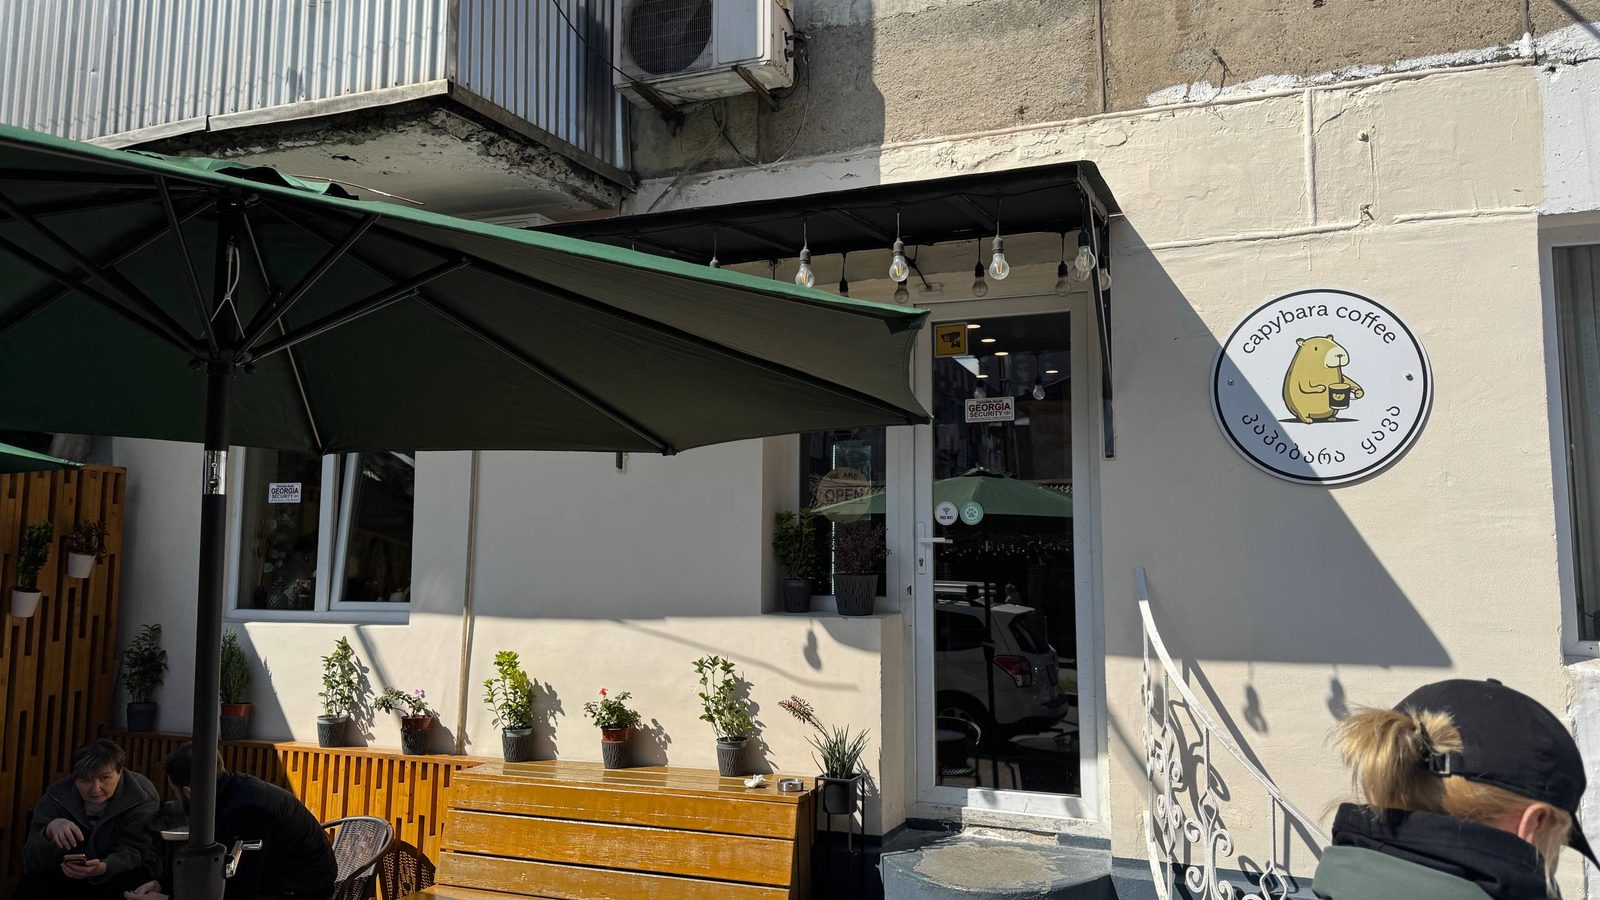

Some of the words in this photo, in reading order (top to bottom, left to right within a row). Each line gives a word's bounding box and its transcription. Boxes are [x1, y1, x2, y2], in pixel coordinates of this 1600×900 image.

[1242, 304, 1329, 354] capybara
[1336, 305, 1396, 345] coffee
[968, 402, 1011, 412] GEORGIA
[969, 410, 1003, 418] SECURITY
[1241, 413, 1346, 465] კაპიბარა
[1361, 405, 1401, 455] ყავა
[828, 472, 841, 480] WE
[843, 471, 859, 480] ARE
[271, 487, 299, 495] GEORGIA
[824, 488, 865, 502] OPEN
